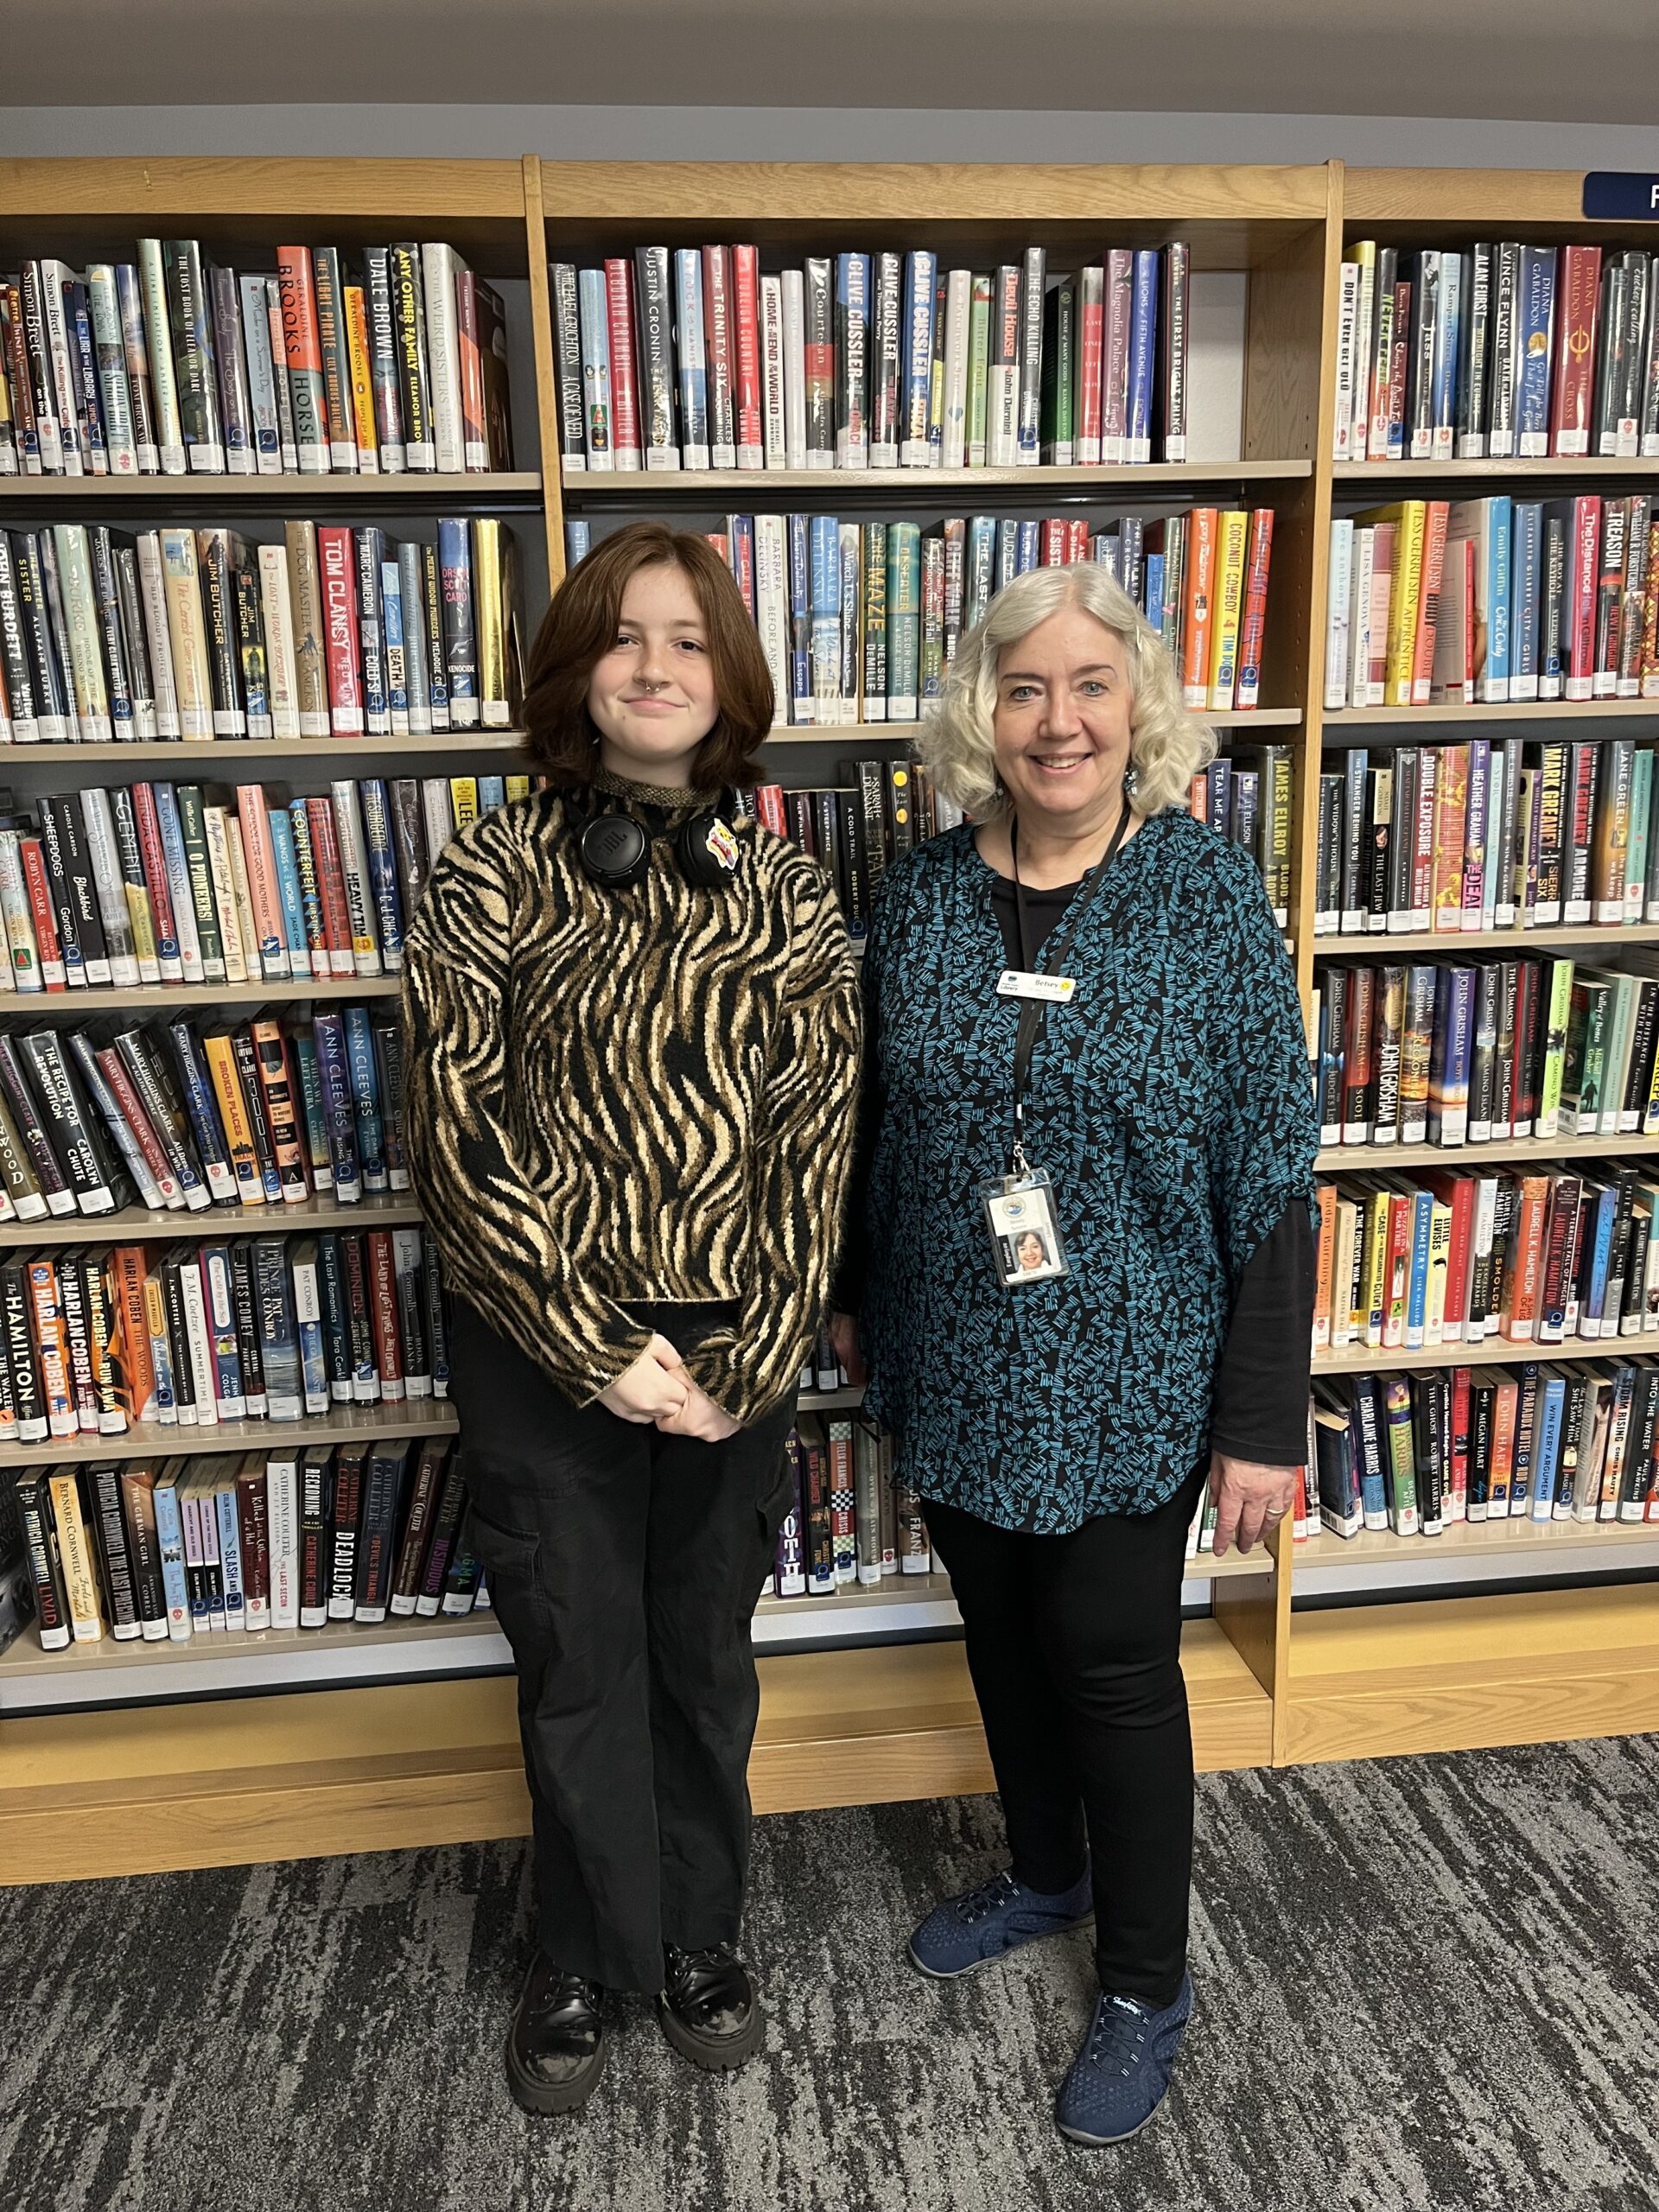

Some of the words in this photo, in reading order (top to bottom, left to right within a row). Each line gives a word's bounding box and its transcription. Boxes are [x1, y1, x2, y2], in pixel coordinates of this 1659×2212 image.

[317, 258, 327, 271] THE
[369, 258, 387, 296] DALE
[645, 253, 658, 300] JUSTIN
[848, 261, 864, 304] CLIVE
[884, 258, 899, 296] CLIVE
[913, 258, 931, 303] CLIVE
[1115, 257, 1124, 278] The
[1475, 255, 1489, 283] ALAN
[1500, 251, 1512, 296] VINCE
[22, 272, 36, 312] Simon
[46, 273, 55, 306] Simon
[317, 276, 334, 305] LIGHT
[1005, 274, 1019, 310] Devil
[1474, 284, 1489, 316] FURST
[1530, 263, 1541, 327] GABALDON
[1541, 276, 1551, 315] DIANA
[1570, 252, 1583, 320] GABALDON
[49, 309, 60, 335] Brett
[278, 265, 301, 353] BROOKS
[296, 279, 308, 340] GERALDINE
[816, 288, 827, 364] Courtesan
[1111, 282, 1124, 334] Magnolia
[1497, 302, 1510, 349] FLYNN
[27, 315, 42, 357] Brett
[79, 336, 91, 353] LIAR
[321, 312, 336, 348] PIRATE
[373, 303, 393, 359] BROWN
[649, 306, 661, 361] CRONIN
[848, 309, 865, 378] CUSSLER
[883, 301, 899, 360] CUSSLER
[912, 307, 929, 377] CUSSLER
[1004, 314, 1017, 357] House
[1112, 338, 1122, 374] Palace
[1137, 346, 1147, 378] AVENUE
[84, 367, 95, 398] LIBRARY
[563, 383, 579, 403] CASE
[294, 377, 315, 444] HORSE
[564, 404, 581, 416] OF
[566, 416, 582, 438] NEED
[1433, 512, 1446, 534] TESS
[1605, 512, 1623, 568] TREASON
[296, 548, 308, 575] DOG
[325, 539, 343, 575] TOM
[980, 534, 990, 563] THE
[1227, 524, 1243, 569] COCONUT
[1427, 536, 1446, 589] GERRITSEN
[18, 559, 31, 602] SISTER
[207, 559, 219, 581] JIM
[843, 551, 854, 582] Watch
[979, 566, 989, 602] LAST
[1408, 537, 1423, 605] GERRITSEN
[298, 581, 311, 629] MASTER
[843, 584, 853, 601] Us
[868, 568, 884, 632] MAZE
[1224, 574, 1241, 613] COWBOY
[1, 589, 22, 660] BURDETT
[210, 585, 224, 644] BUTCHER
[238, 591, 250, 638] BUTCHER
[328, 581, 349, 650] CLANCY
[843, 603, 853, 629] Shine
[1223, 635, 1235, 652] TIM
[365, 656, 379, 681] COLD
[390, 648, 403, 681] DEATH
[1215, 767, 1224, 795] TEAR
[1274, 760, 1288, 803] JAMES
[1420, 756, 1434, 797] DOUBLE
[1543, 748, 1563, 787] MARK
[1575, 747, 1592, 786] MARK
[1215, 799, 1224, 814] ME
[1470, 769, 1484, 809] HEATHER
[137, 795, 155, 837] LINDA
[161, 807, 174, 842] GONE
[1273, 808, 1287, 855] ELLROY
[1418, 801, 1433, 857] EXPOSURE
[1468, 811, 1480, 847] GRAHAM
[1540, 791, 1560, 848] GREANEY
[1573, 789, 1591, 843] GREANEY
[116, 804, 141, 874] GEMINI
[603, 831, 628, 855] JBL
[43, 815, 64, 877] SHEEPDOGS
[60, 907, 74, 941] Gordon
[144, 841, 166, 910] CASTILLO
[167, 846, 185, 895] MISSING
[276, 834, 289, 864] WANGS
[283, 881, 296, 912] WORLD
[293, 810, 315, 895] COUNTERFEIT
[308, 903, 319, 932] KIRSTIN
[346, 872, 364, 914] HEAVY
[1035, 979, 1058, 988] Betsey
[1458, 975, 1469, 1005] JOHN
[1508, 967, 1516, 984] THE
[1505, 986, 1516, 1031] SUMMONS
[324, 1026, 339, 1058] ANN
[351, 1017, 363, 1050] ANN
[1455, 1007, 1467, 1056] GRISHAM
[1381, 1043, 1400, 1072] JOHN
[1502, 1059, 1513, 1083] JOHN
[34, 1057, 64, 1120] REVOLUTION
[44, 1046, 56, 1066] THE
[52, 1069, 67, 1104] RECIPE
[65, 1106, 79, 1127] FOR
[219, 1061, 234, 1098] BROKEN
[228, 1102, 243, 1137] PLACES
[329, 1065, 346, 1127] CLEEVES
[355, 1056, 373, 1116] CLEEVES
[1378, 1073, 1397, 1122] GRISHAM
[1501, 1084, 1512, 1123] GRISHAM
[67, 1148, 85, 1181] CHUTE
[76, 1139, 99, 1185] CAROLYN
[1353, 1230, 1363, 1263] FOREVER
[1417, 1204, 1429, 1270] ASYMMETRY
[7, 1283, 16, 1296] The
[234, 1262, 249, 1297] JAMES
[1352, 1265, 1361, 1283] WAR
[35, 1288, 59, 1345] HARLAN
[62, 1281, 82, 1337] HARLAN
[238, 1302, 253, 1337] COMEY
[6, 1296, 35, 1401] HAMILTON
[71, 1339, 91, 1383] COBEN
[44, 1351, 66, 1396] COBEN
[1360, 1397, 1376, 1442] CHARLAINE
[1498, 1401, 1509, 1433] JOHN
[836, 1442, 848, 1461] FELIX
[1496, 1436, 1507, 1468] HART
[1545, 1425, 1554, 1452] EVERY
[836, 1462, 849, 1488] FRANCIS
[1364, 1444, 1380, 1474] HARRIS
[1540, 1454, 1552, 1500] ARGUMENT
[132, 1487, 141, 1503] THE
[303, 1469, 321, 1516] RECKONING
[24, 1510, 43, 1544] PATRICIA
[59, 1483, 73, 1523] BERNARD
[67, 1526, 81, 1574] CORNWELL
[134, 1507, 146, 1543] GERMAN
[837, 1512, 849, 1534] CRISIS
[31, 1546, 50, 1584] CORNWELL
[139, 1546, 149, 1567] GIRL
[225, 1550, 238, 1579] SLASH
[425, 1539, 449, 1592] INSIDIOUS
[39, 1586, 57, 1624] LIVID
